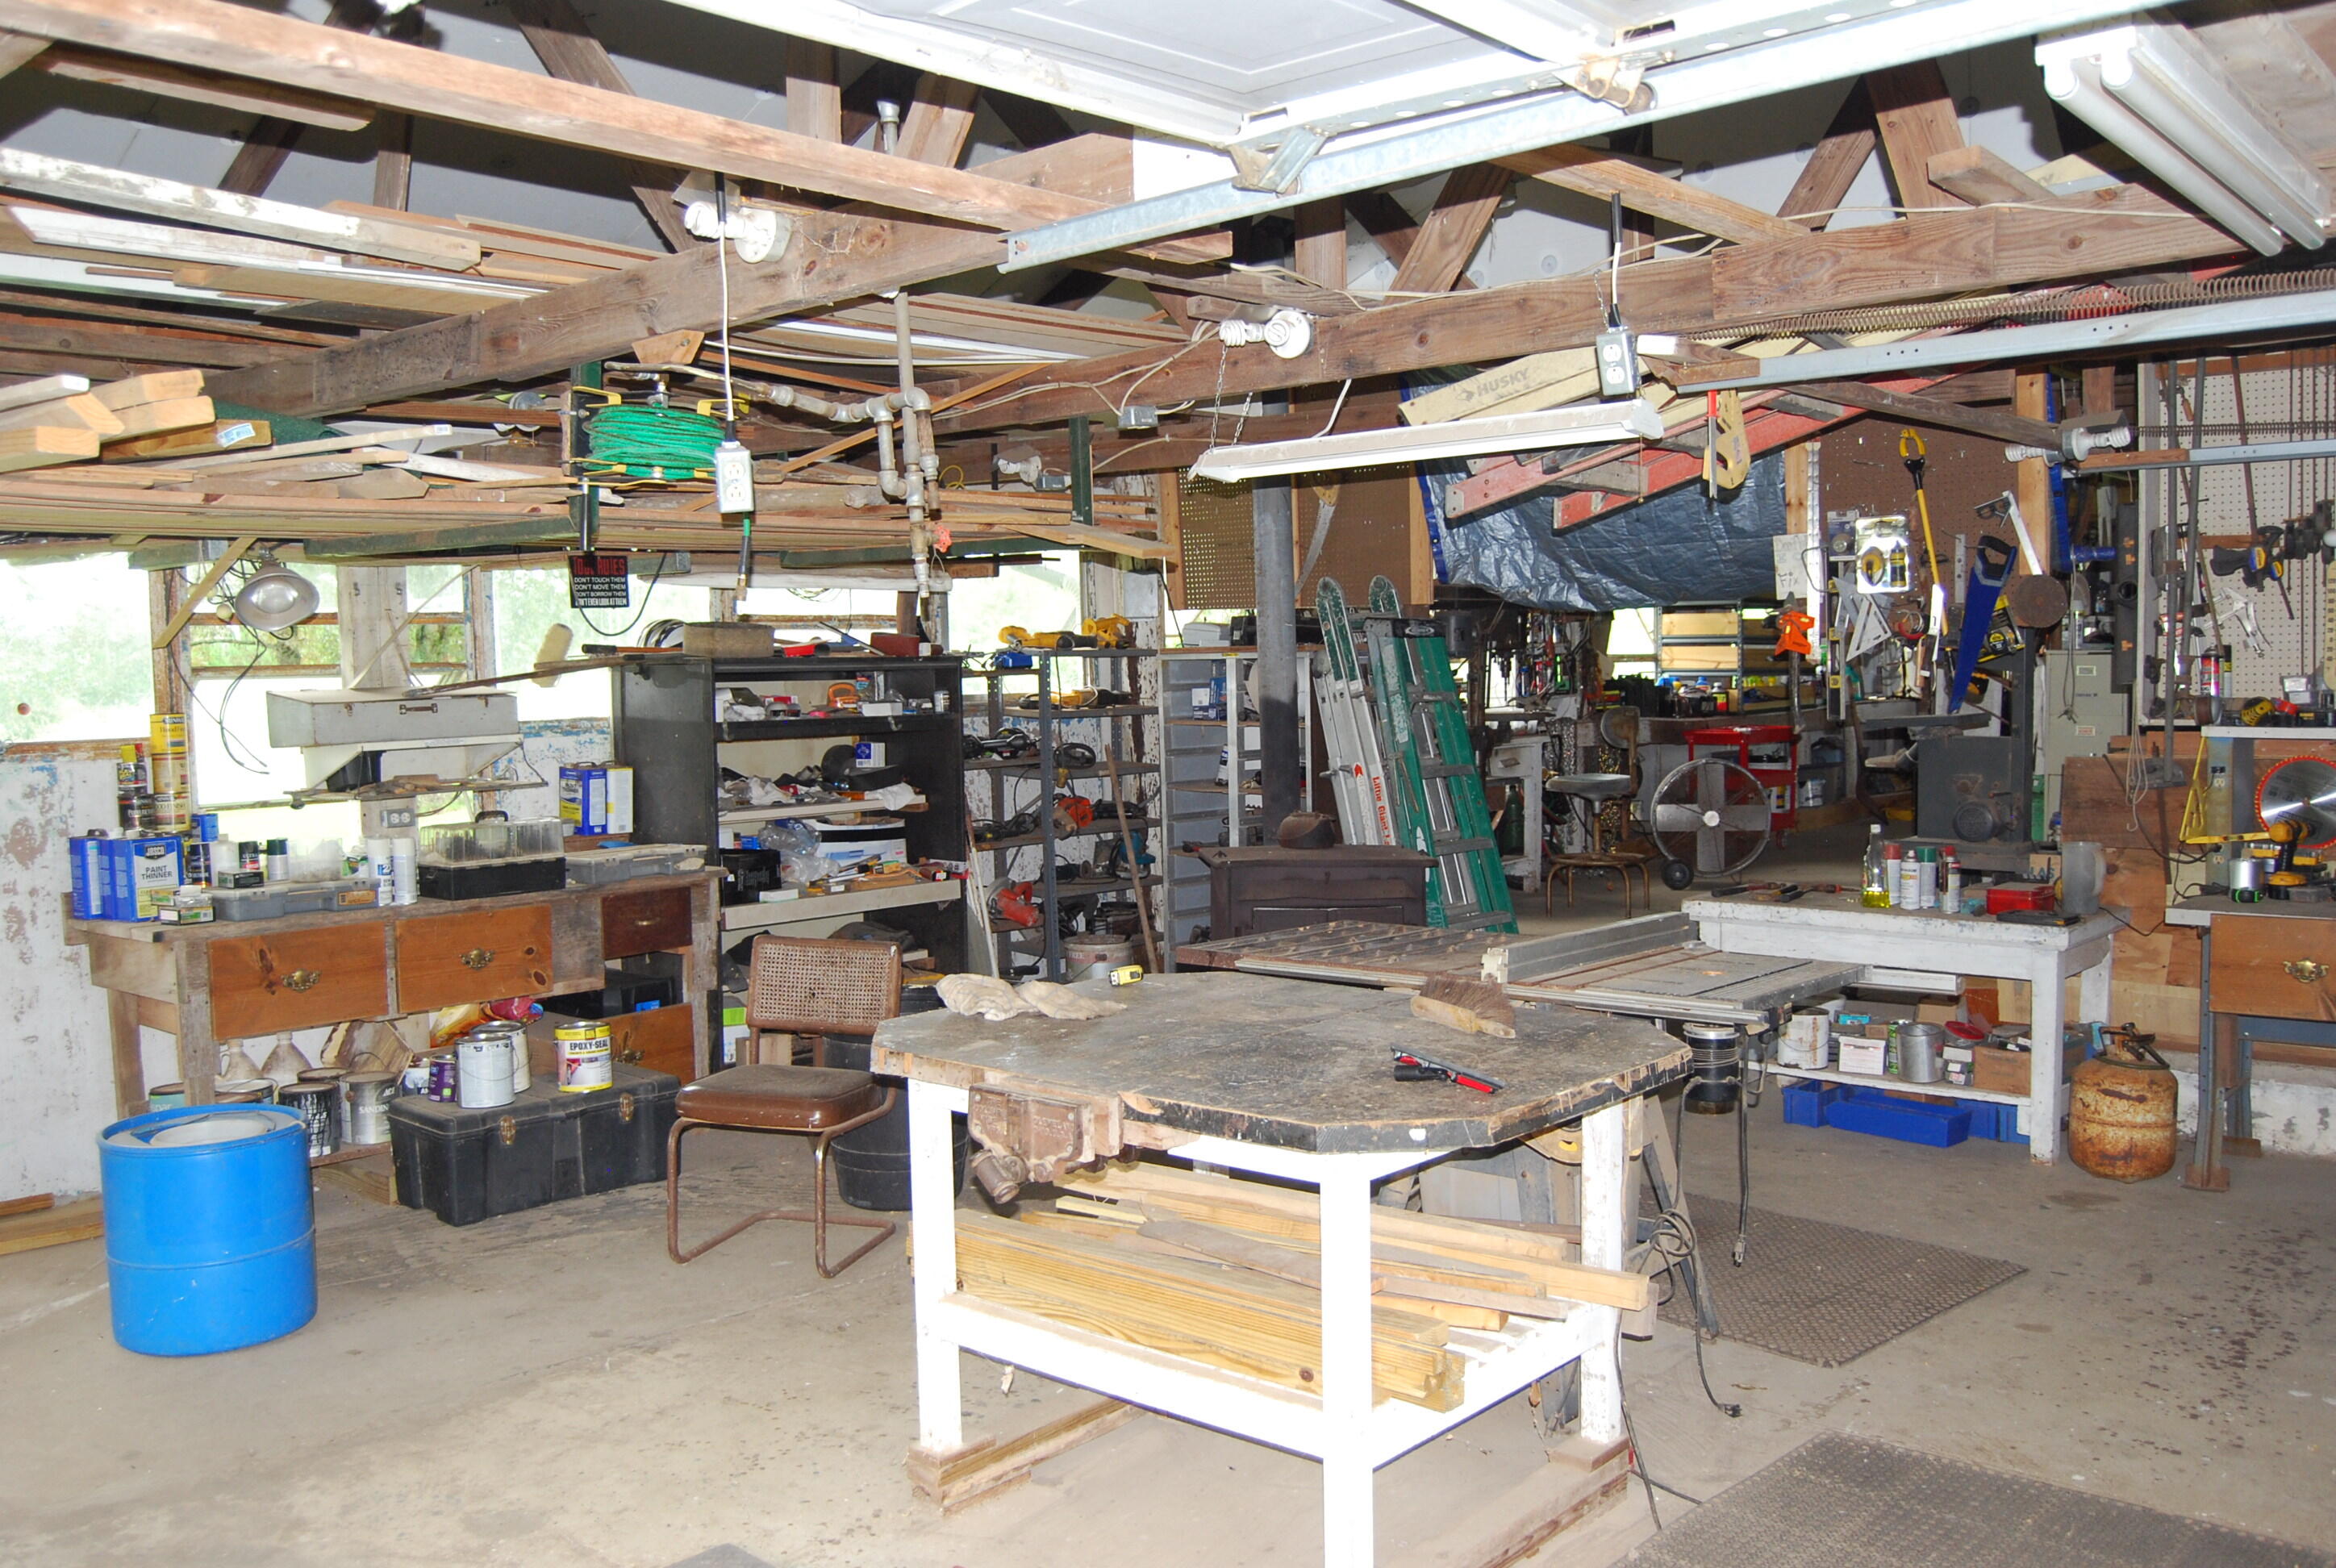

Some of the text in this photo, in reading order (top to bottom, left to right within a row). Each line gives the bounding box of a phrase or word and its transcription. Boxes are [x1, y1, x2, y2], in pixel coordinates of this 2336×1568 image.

[1477, 368, 1529, 396] HUSKY
[575, 598, 587, 607] DN'T
[1372, 776, 1383, 803] Little
[1378, 805, 1389, 831] Giant
[145, 865, 168, 874] PAINT
[141, 870, 173, 881] THINNER
[569, 1038, 608, 1051] EPOXY-SEAL
[382, 1086, 395, 1097] ACE
